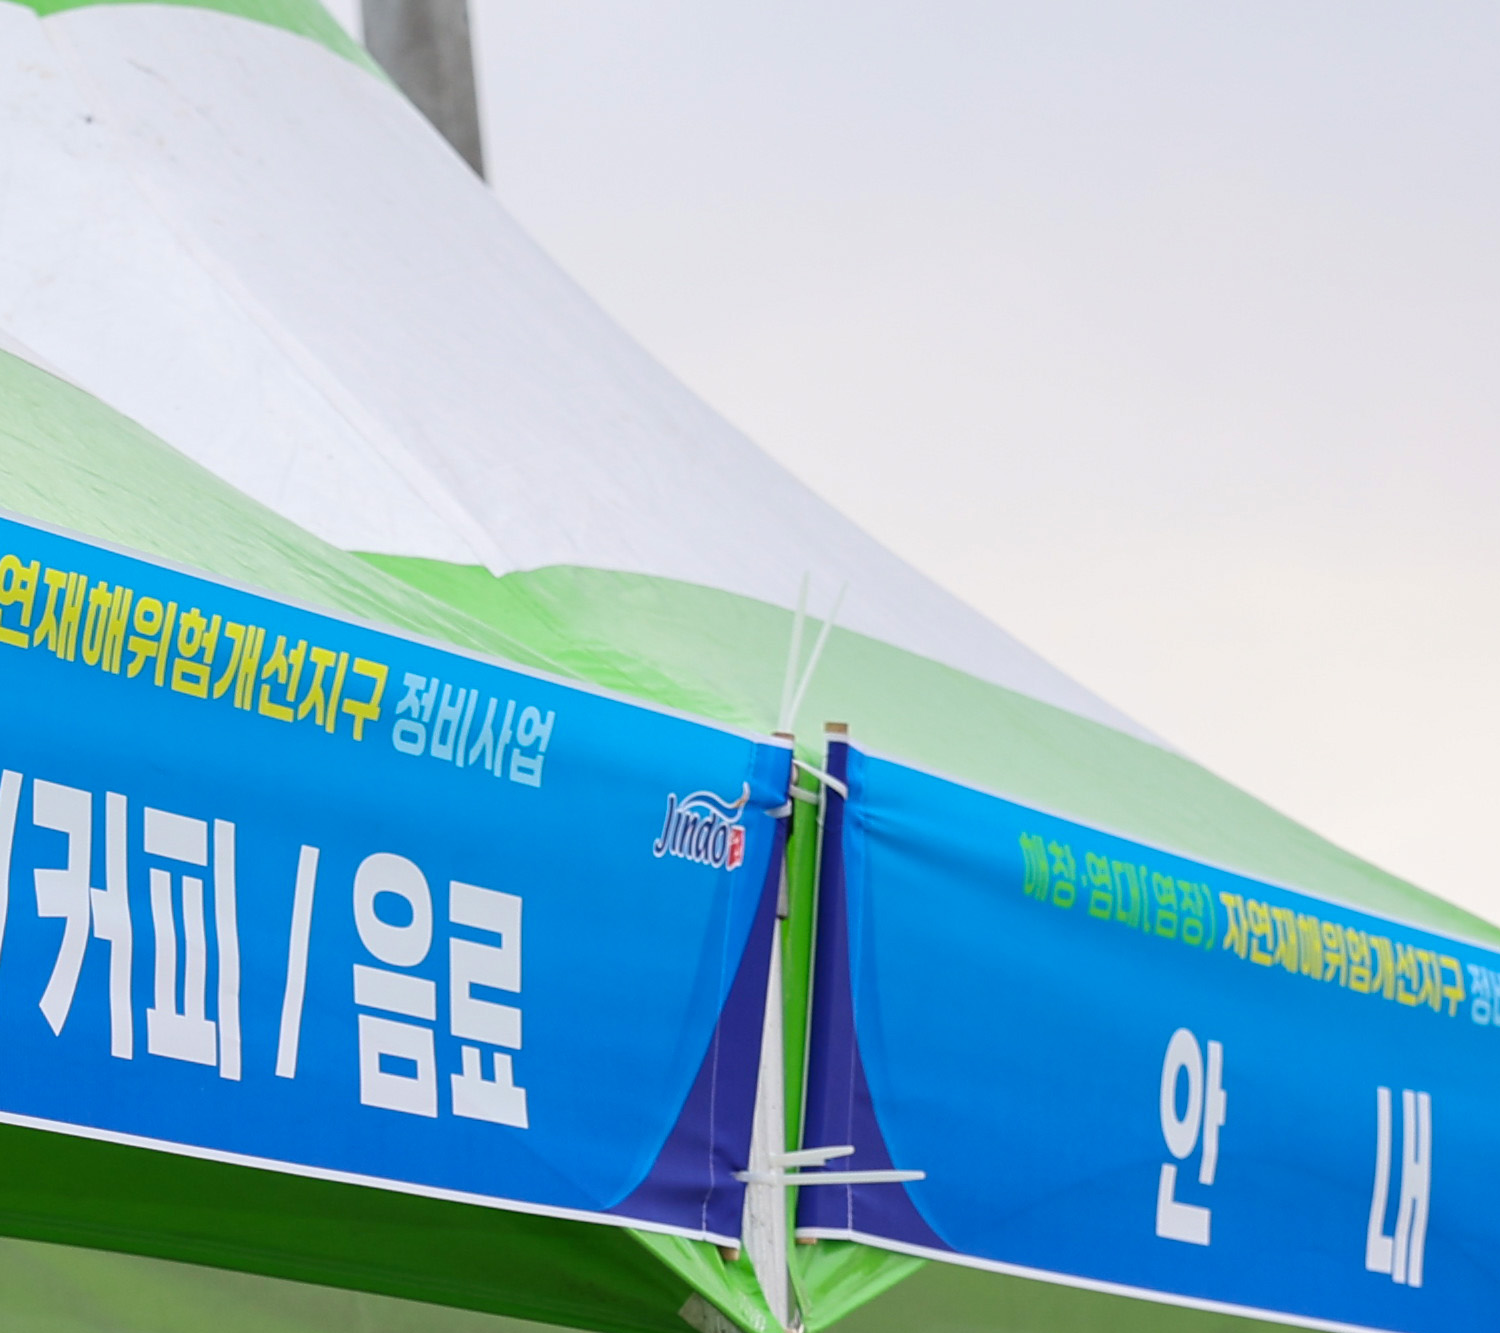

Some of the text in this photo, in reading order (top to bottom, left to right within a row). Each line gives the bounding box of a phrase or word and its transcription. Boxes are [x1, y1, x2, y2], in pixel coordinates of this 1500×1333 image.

[392, 672, 555, 788] 정비사업
[653, 792, 731, 868] Jindo
[352, 852, 528, 1128] 음료
[1219, 891, 1466, 1017] 자연재해위험개선지구
